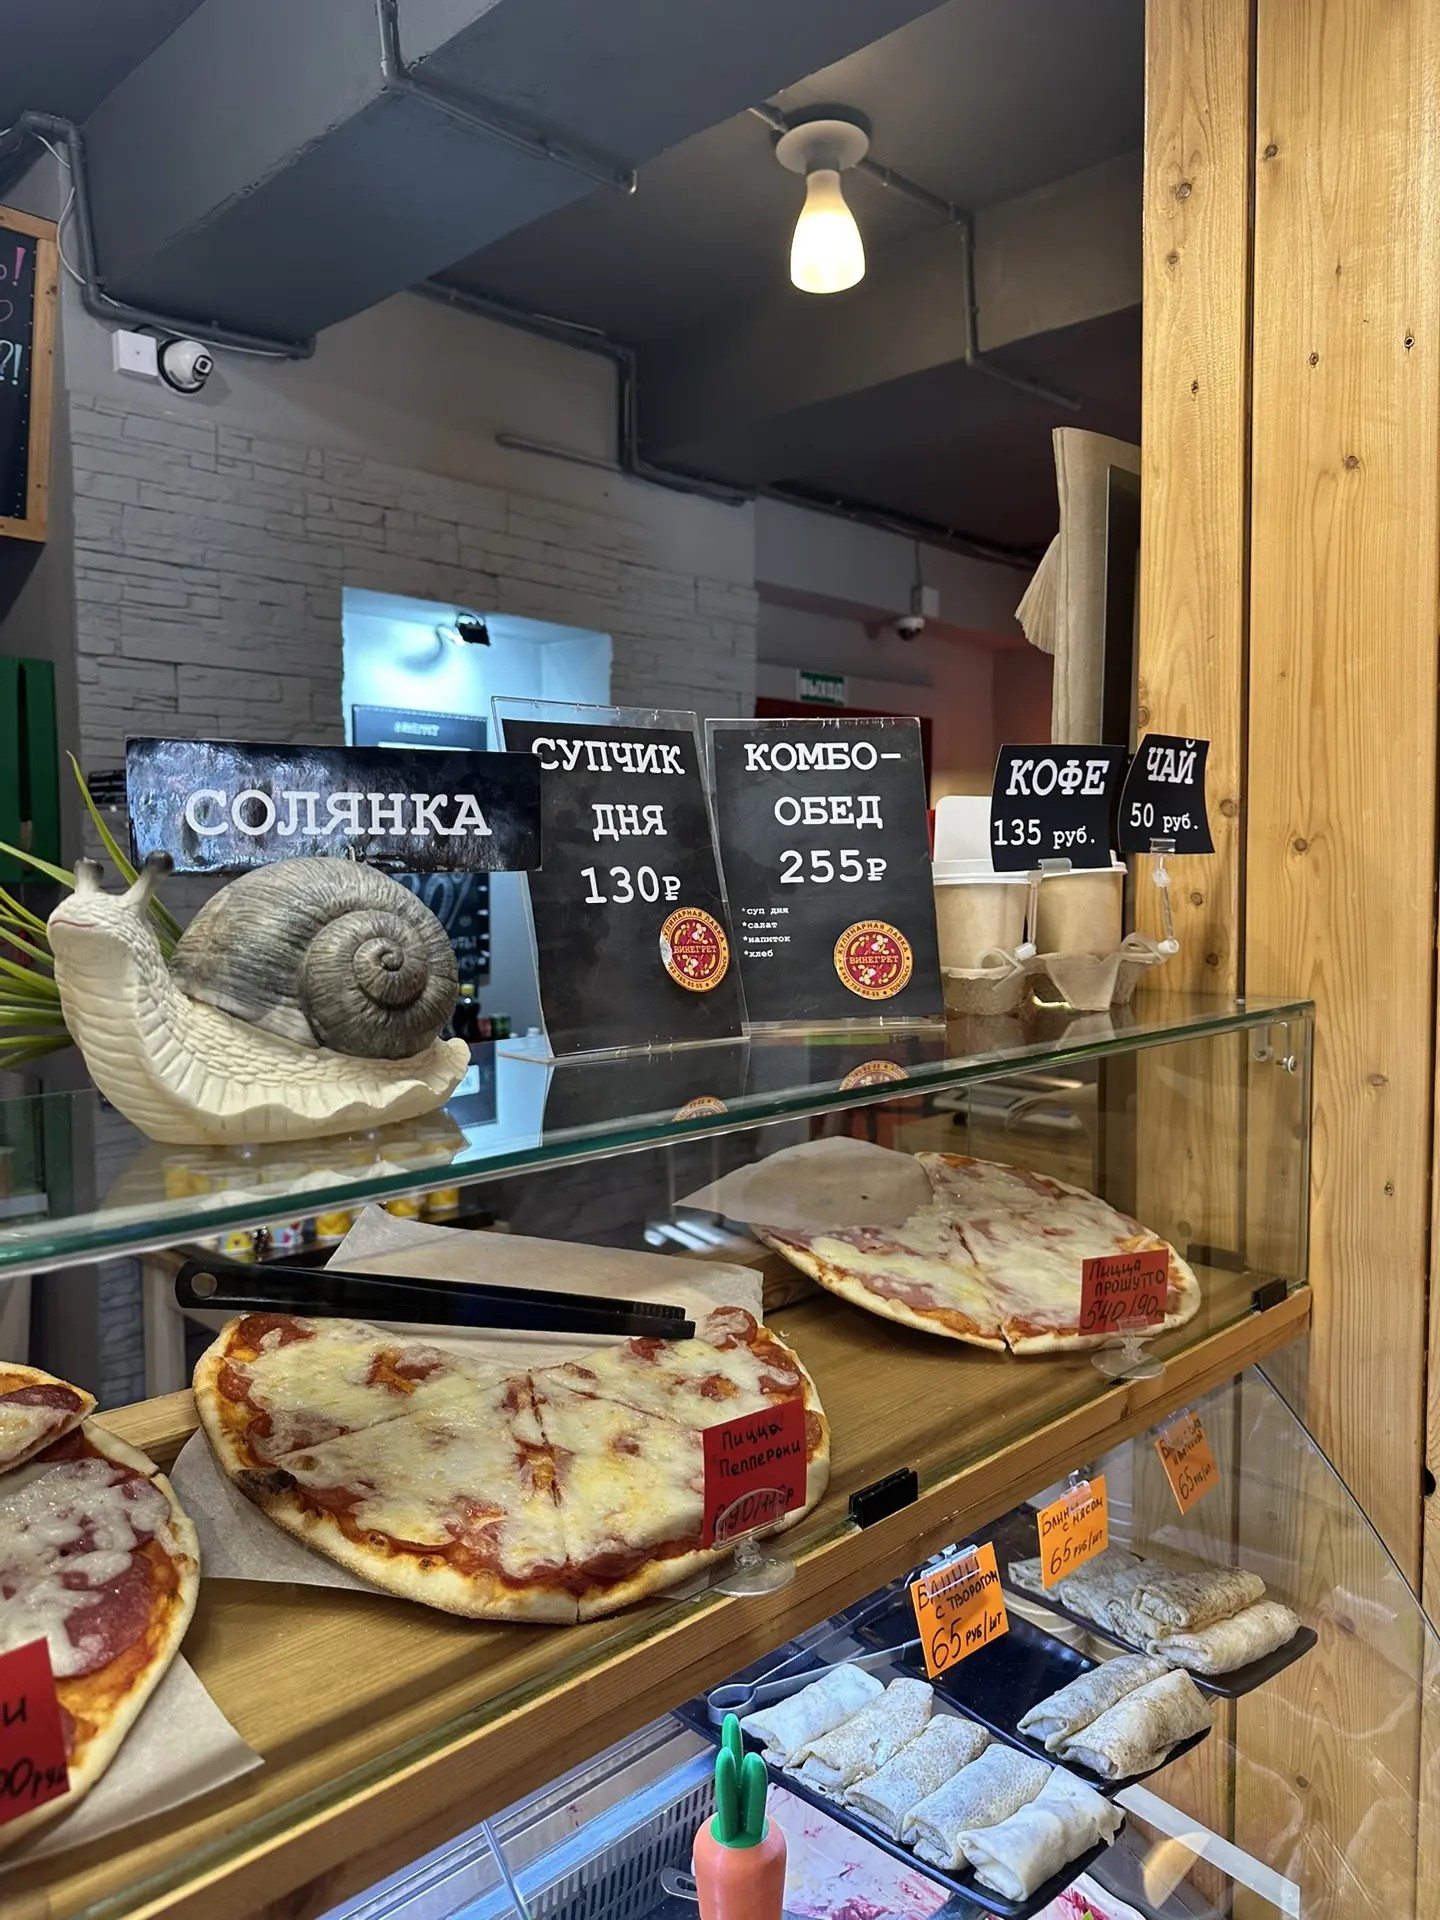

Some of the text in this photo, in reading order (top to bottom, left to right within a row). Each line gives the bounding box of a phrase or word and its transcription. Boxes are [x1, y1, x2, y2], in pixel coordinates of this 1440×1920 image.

[531, 737, 686, 775] СУПЧИК
[743, 741, 902, 772] КОМБО-
[1146, 740, 1198, 785] ЧАЙ
[1005, 758, 1110, 796] КОФЕ
[185, 789, 493, 836] СОЛЯНКА
[591, 803, 668, 842] ДНЯ
[774, 795, 884, 830] ОБЕД
[1130, 802, 1199, 834] 50 руб.
[994, 819, 1096, 850] 135 руб.
[663, 910, 725, 943] УЛИНАРНАЯ ЛАВКА
[770, 907, 789, 915] дня
[672, 945, 717, 954] ВИНЕГРЕТ
[837, 923, 910, 954] КУЛИНАРНАЯ ЛАВКА
[849, 955, 899, 965] ВИНЕГРЕТ
[1178, 1465, 1195, 1500] 65
[1050, 1537, 1073, 1575] 65
[931, 1617, 962, 1669] 65
